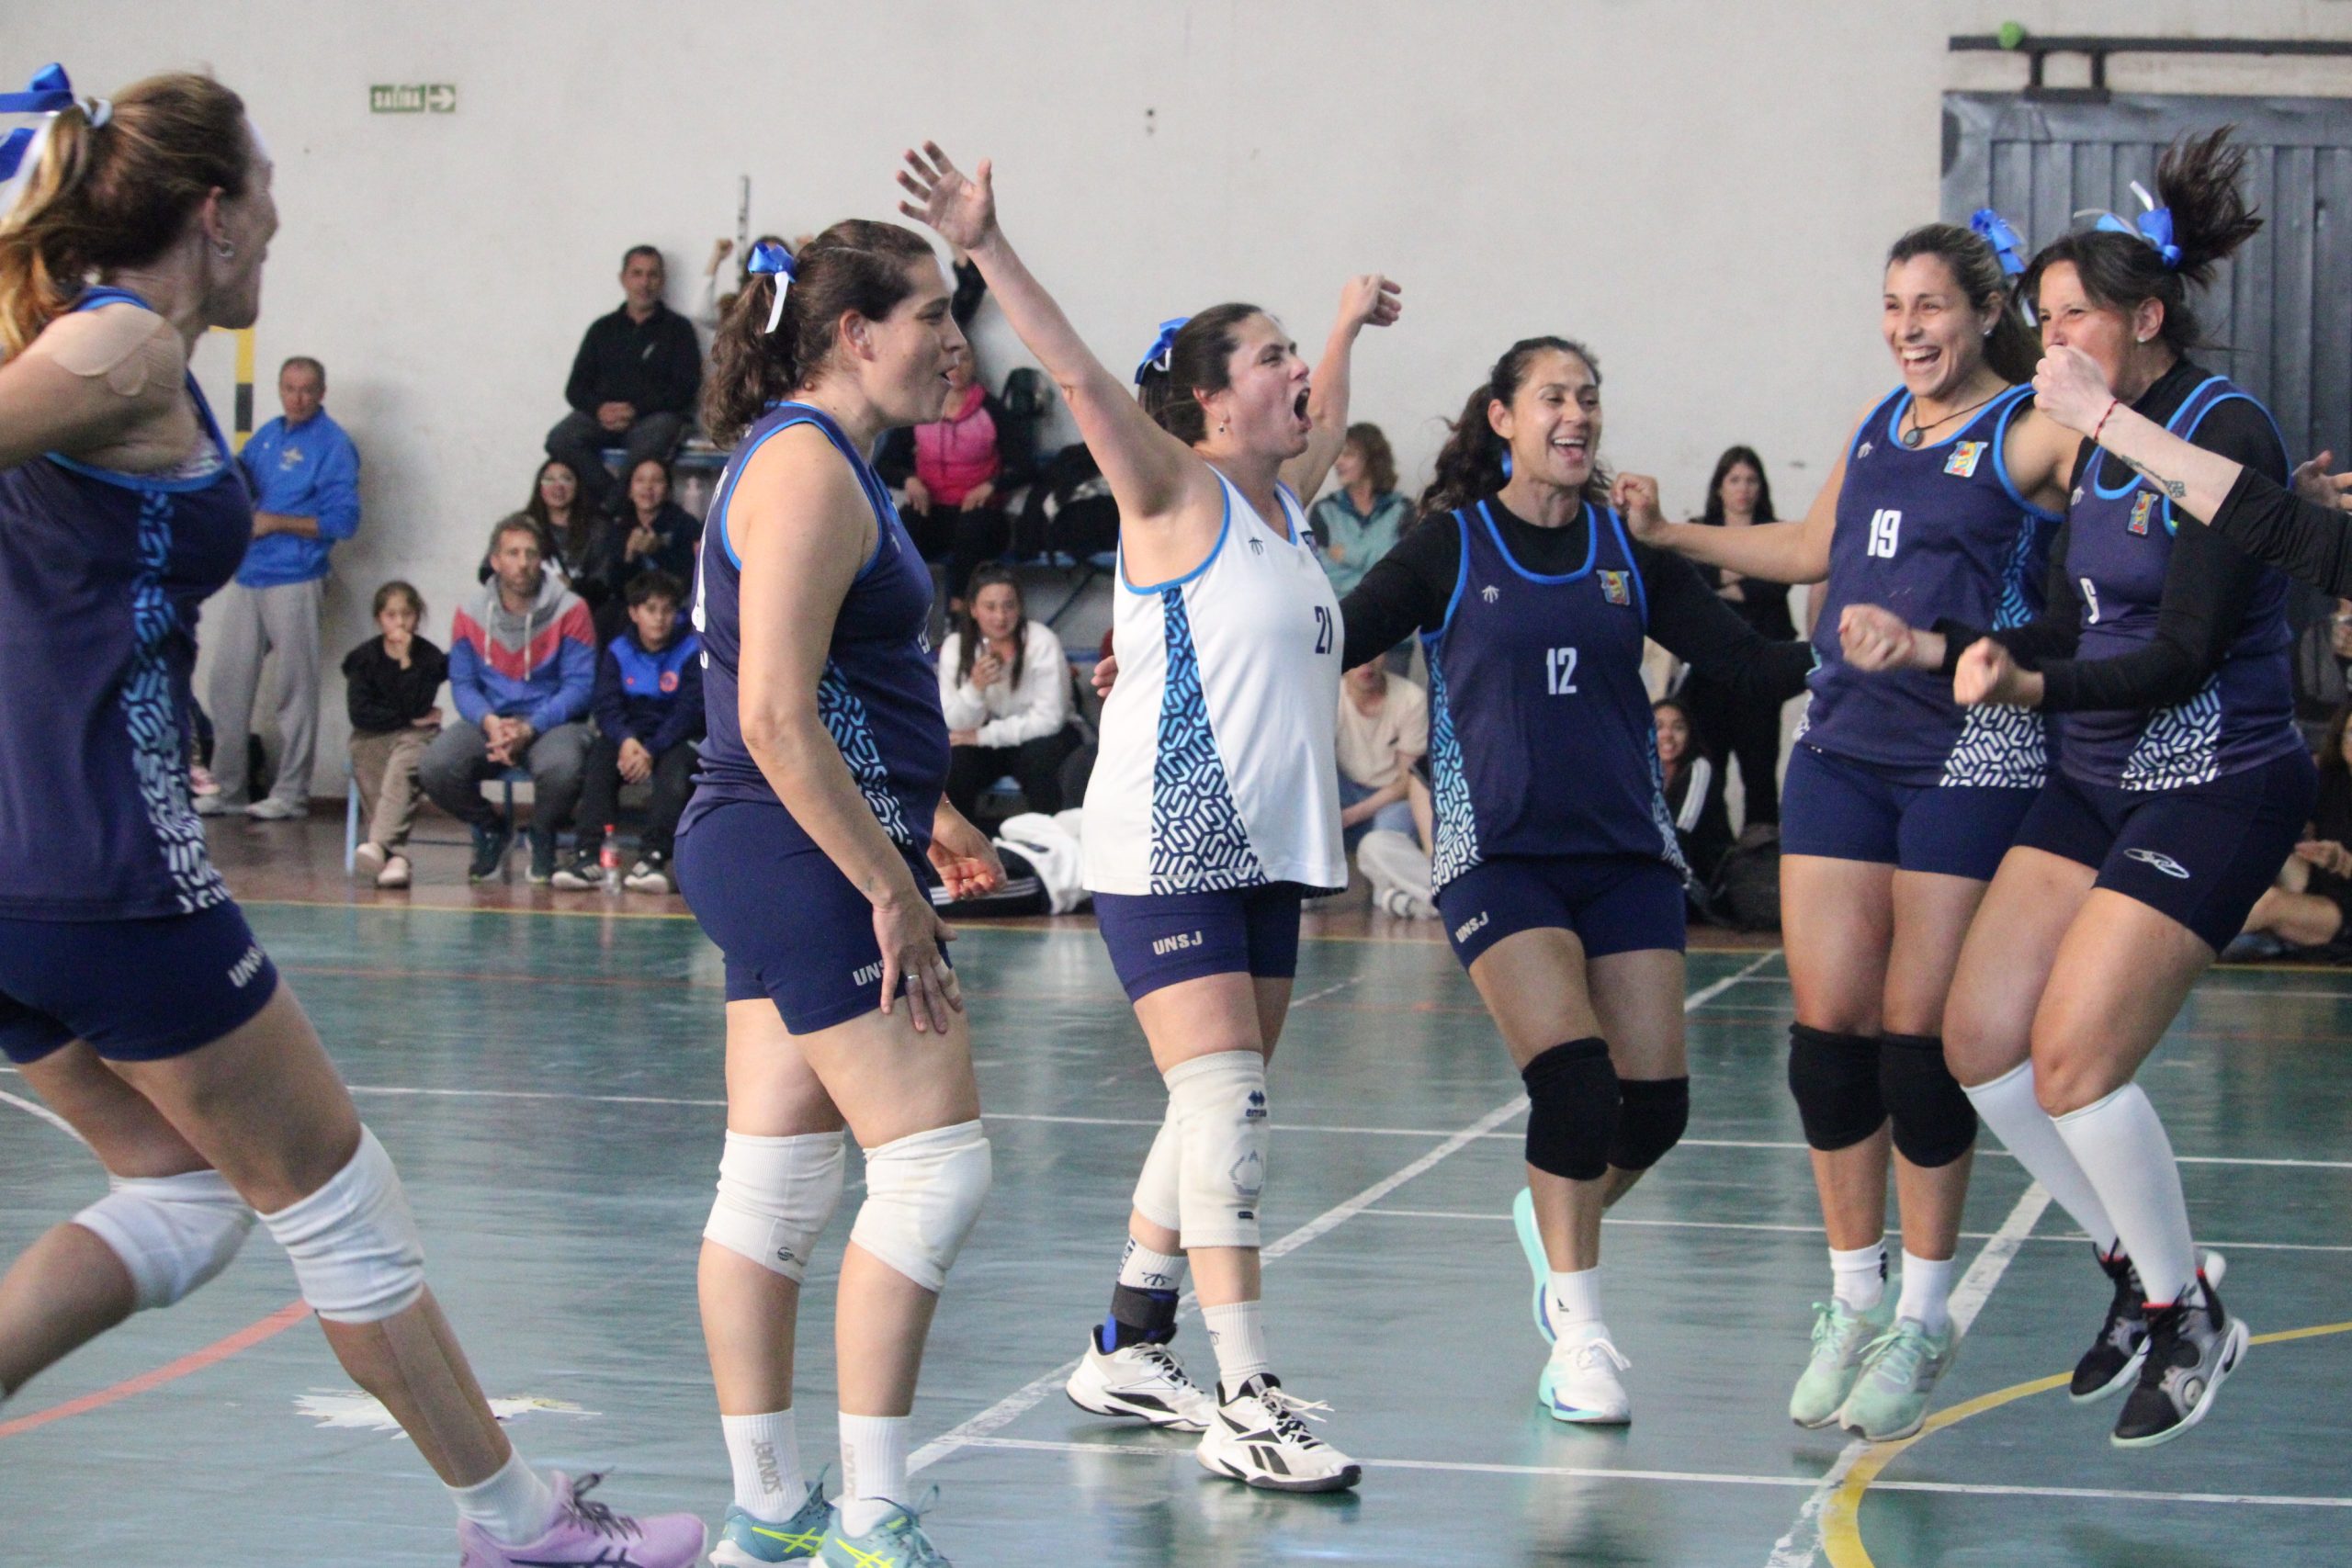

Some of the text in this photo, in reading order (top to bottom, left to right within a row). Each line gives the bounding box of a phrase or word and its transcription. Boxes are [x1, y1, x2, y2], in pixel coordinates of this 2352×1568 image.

[1867, 508, 1903, 558] 19
[1314, 605, 1333, 654] 21
[1545, 647, 1577, 695] 12
[1152, 931, 1203, 955] UNSJ
[1454, 910, 1489, 943] UNSJ
